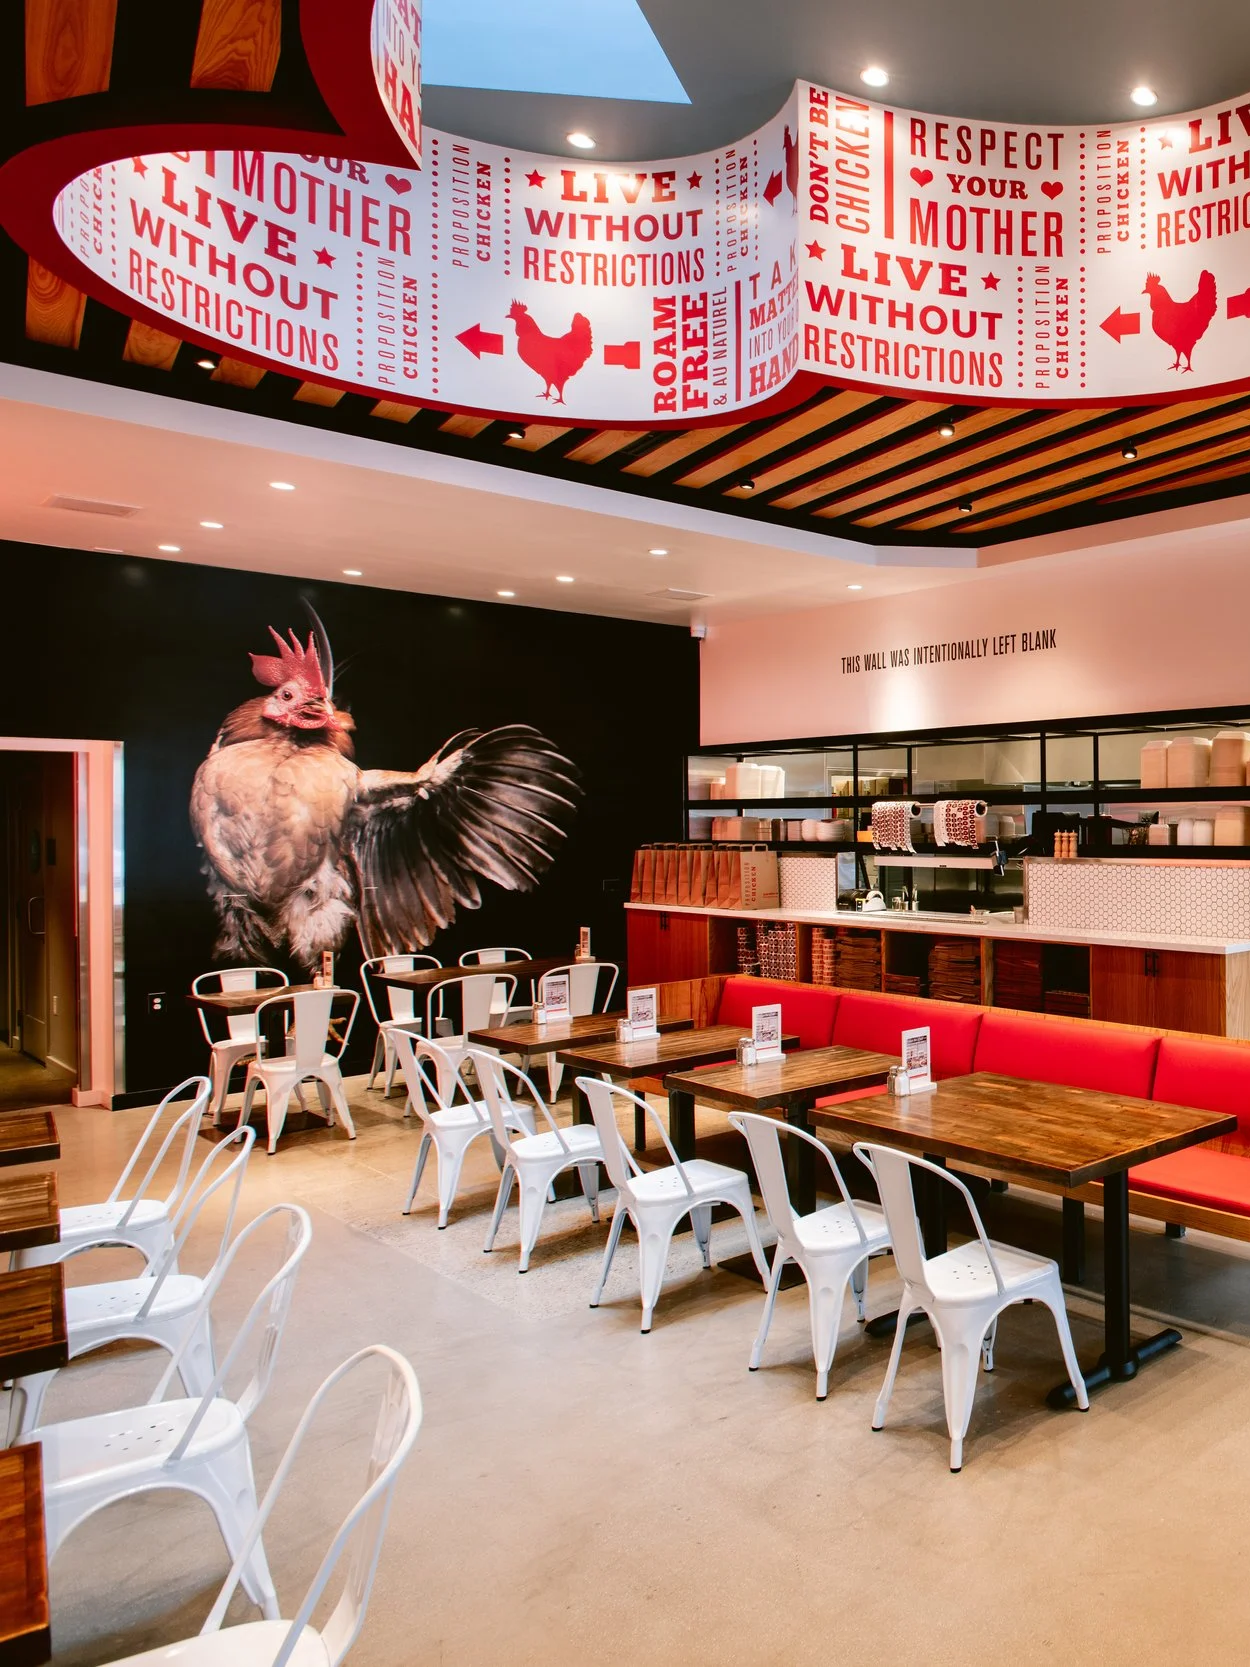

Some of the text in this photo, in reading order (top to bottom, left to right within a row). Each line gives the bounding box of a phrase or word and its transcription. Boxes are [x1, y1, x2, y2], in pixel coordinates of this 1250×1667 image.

[560, 168, 677, 204] LIVE
[808, 86, 830, 226] DON'T BE
[835, 95, 871, 236] CHICKEN
[909, 116, 1065, 171] RESPECT
[946, 172, 1029, 201] YOUR
[1096, 128, 1113, 254] PROPOSITION
[1116, 139, 1130, 243] CHICKEN
[93, 166, 104, 256] CHICK
[161, 165, 298, 267] LIVE
[231, 151, 412, 257] MOTHER
[453, 143, 471, 269] PROPOSITION
[476, 160, 495, 263] CHICKEN
[523, 205, 704, 242] WITHOUT
[726, 147, 738, 273] PROPOSITION
[739, 155, 749, 258] CHICKEN
[909, 196, 1065, 258] MOTHER
[129, 196, 340, 321] WITHOUT
[129, 246, 339, 372] RESTRICTIONS
[522, 244, 706, 288] RESTRICTIONS
[840, 243, 968, 298] LIVE
[377, 257, 397, 387] PROPOSITION
[402, 275, 419, 380] CHICKEN
[652, 295, 677, 414] ROAM
[681, 291, 709, 412] FREE
[713, 287, 728, 407] & AU NATUREL
[749, 328, 773, 360] INTO
[803, 280, 1003, 341] WITHOUT
[803, 323, 1004, 389] RESTRICTIONS
[1035, 264, 1052, 390] PROPOSITION
[1056, 277, 1070, 380] CHICKEN
[748, 332, 799, 398] HAND
[841, 628, 1058, 675] THIS WALL WAS INTENTIONALLY LEFT BLANK
